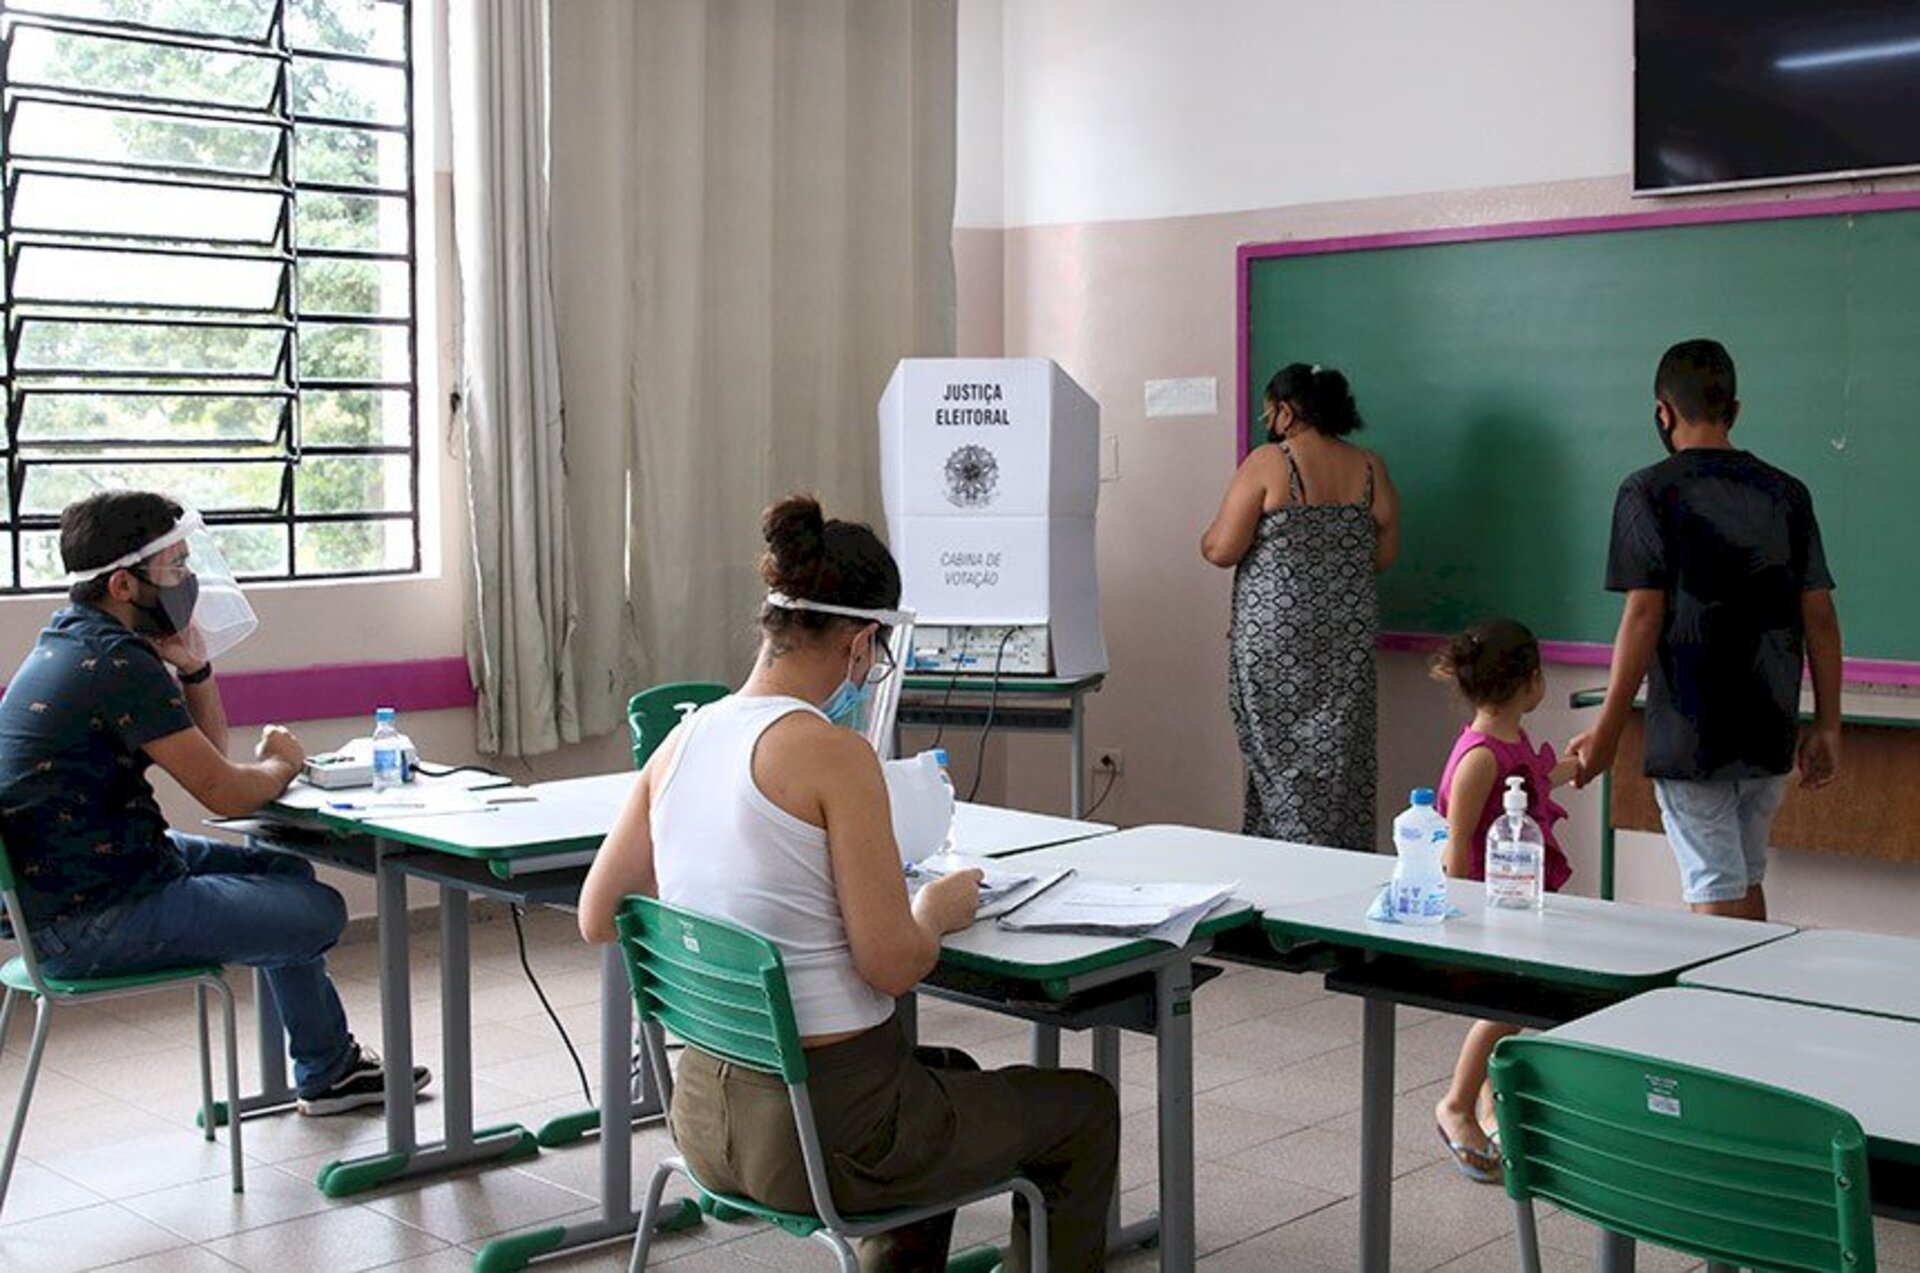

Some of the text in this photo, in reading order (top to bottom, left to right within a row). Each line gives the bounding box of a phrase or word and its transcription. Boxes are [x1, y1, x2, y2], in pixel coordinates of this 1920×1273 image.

[943, 384, 1003, 405] JUSTIÇA
[936, 409, 1010, 425] ELEITORAL
[940, 552, 1002, 567] CABINA DE
[943, 569, 999, 589] VOTAÇÃO
